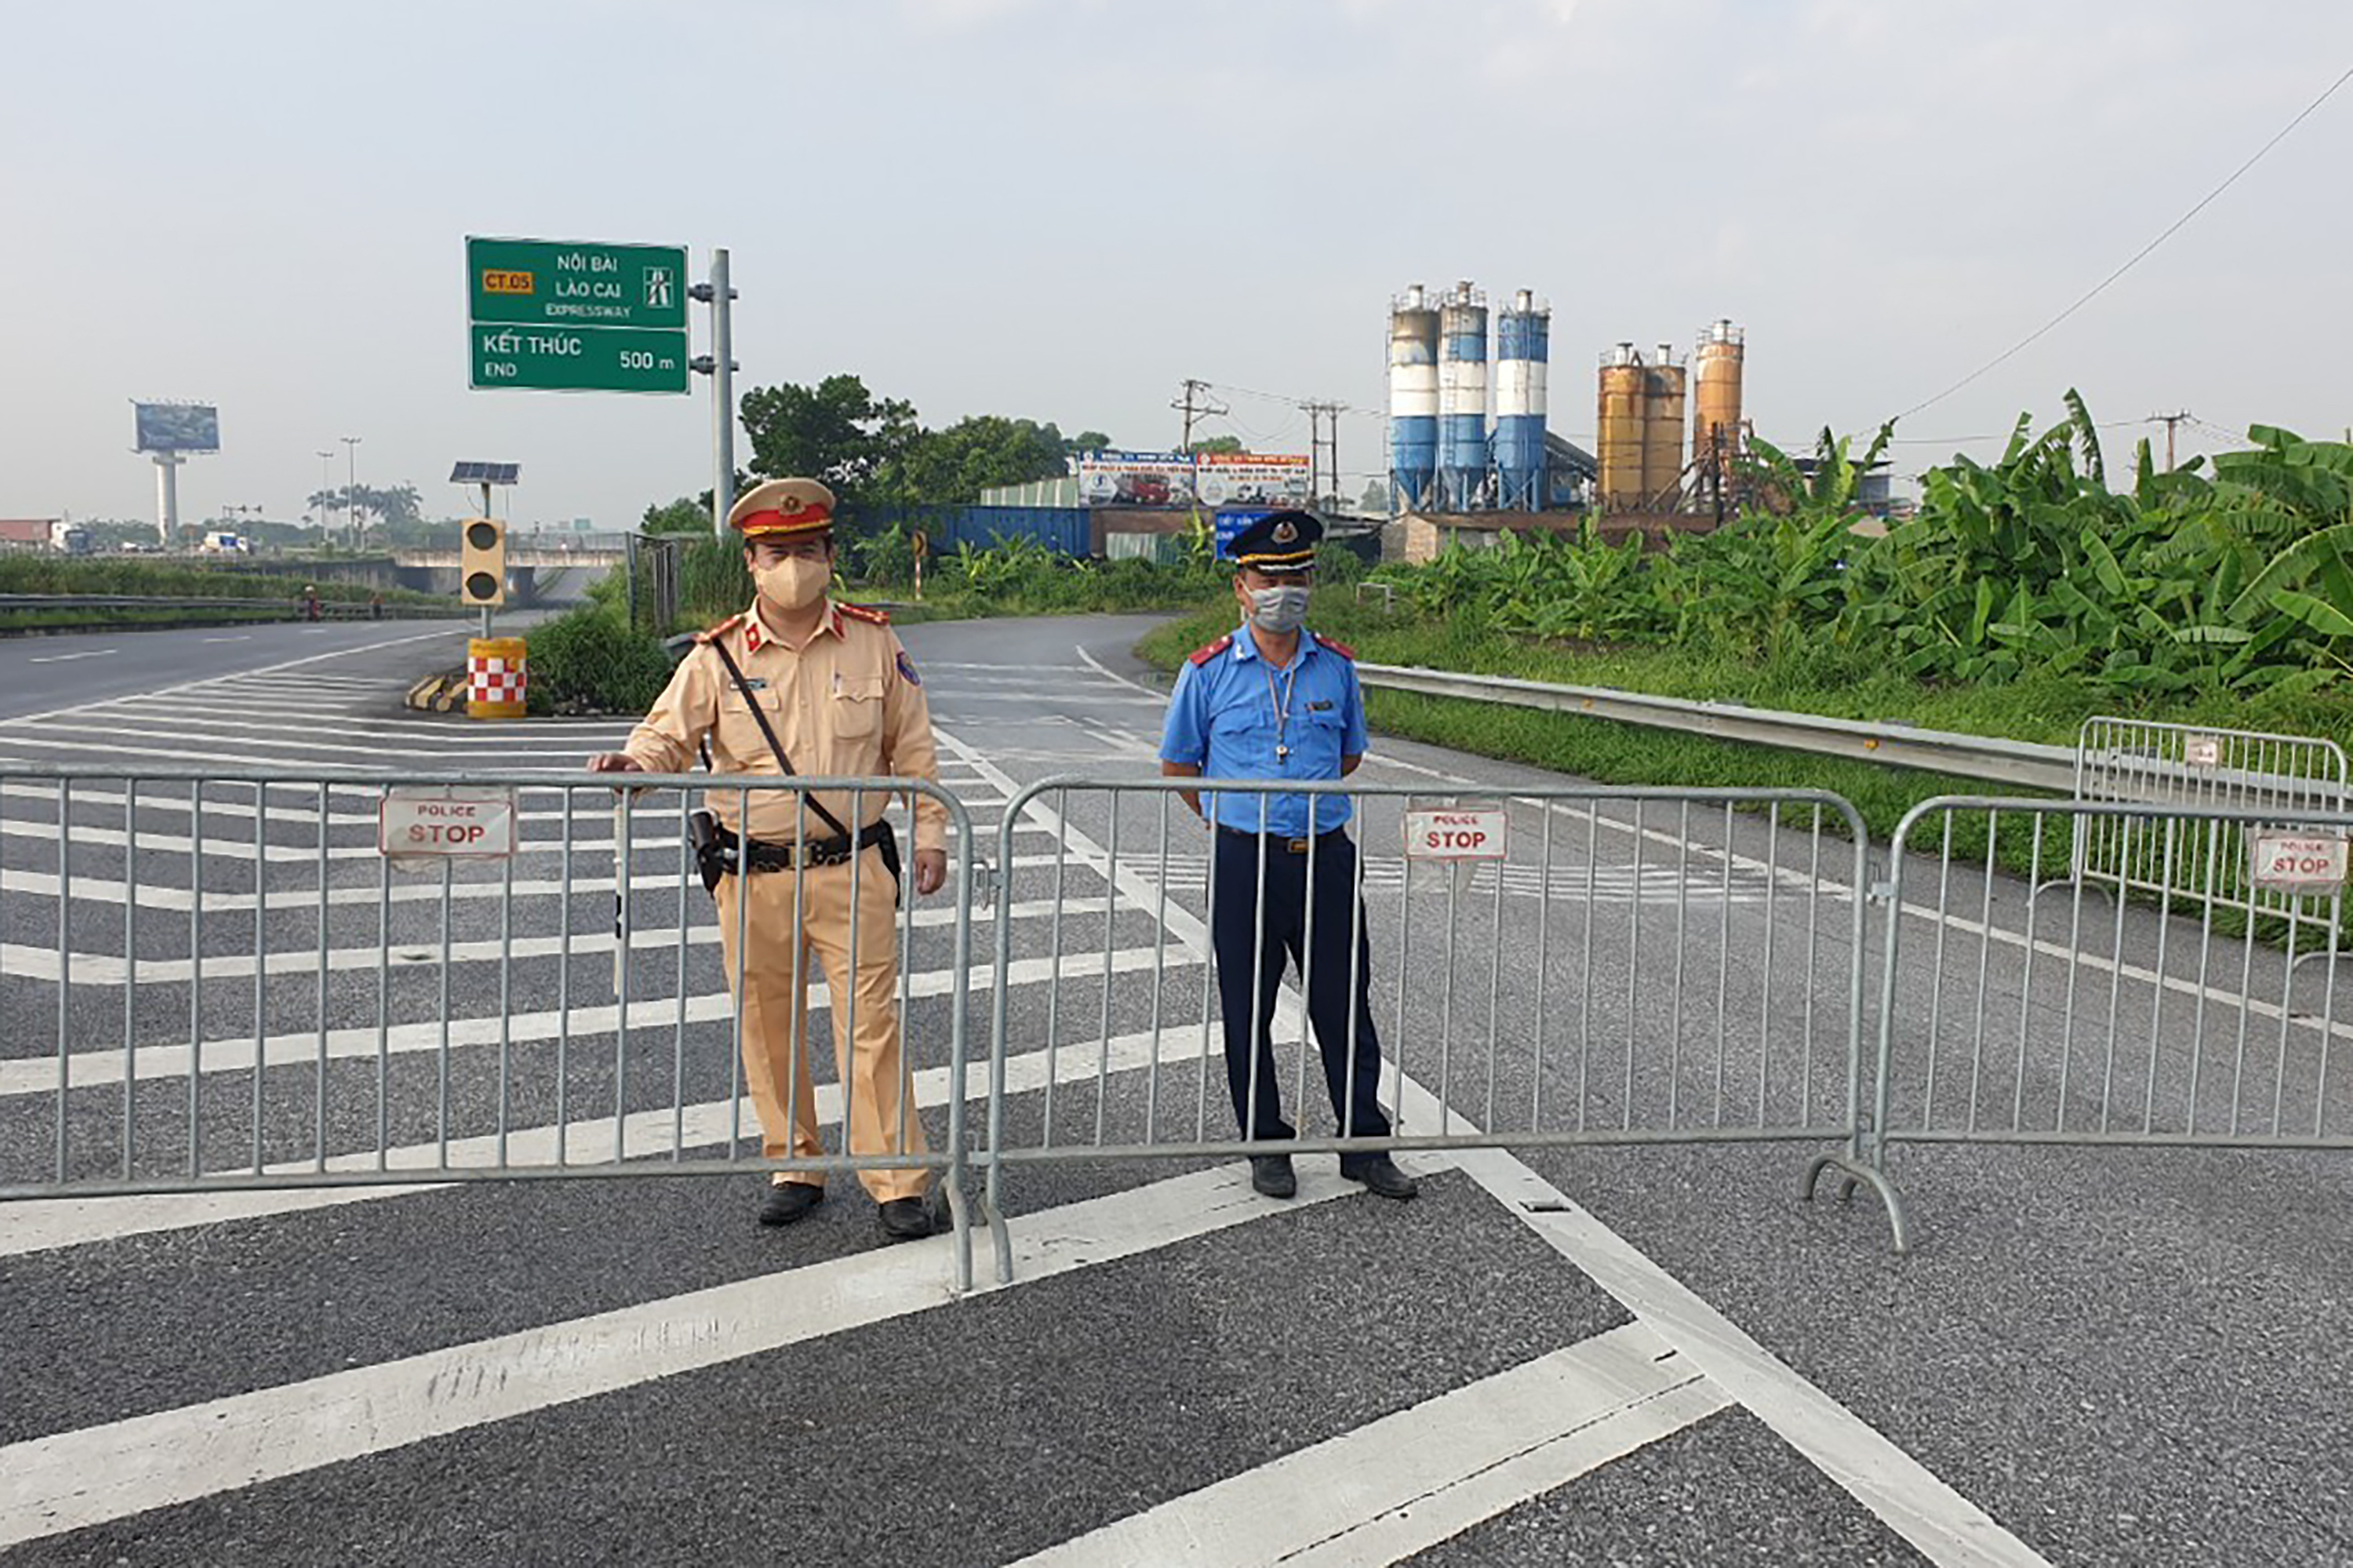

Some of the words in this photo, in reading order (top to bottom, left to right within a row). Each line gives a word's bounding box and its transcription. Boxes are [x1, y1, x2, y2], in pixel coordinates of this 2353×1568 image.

[557, 253, 586, 274] NỘI
[591, 253, 617, 272] BÀI
[485, 272, 530, 289] CT.05
[555, 277, 590, 297] LÀO
[593, 282, 620, 298] CAI
[545, 303, 632, 318] EXPRESSWAY
[483, 328, 523, 353] KẾT
[526, 332, 582, 356] THÚC
[620, 350, 653, 369] 500
[485, 362, 518, 377] END
[417, 804, 476, 817] POLICE
[408, 824, 485, 843] STOP
[1427, 831, 1486, 848] STOP
[2273, 857, 2329, 874] STOP
